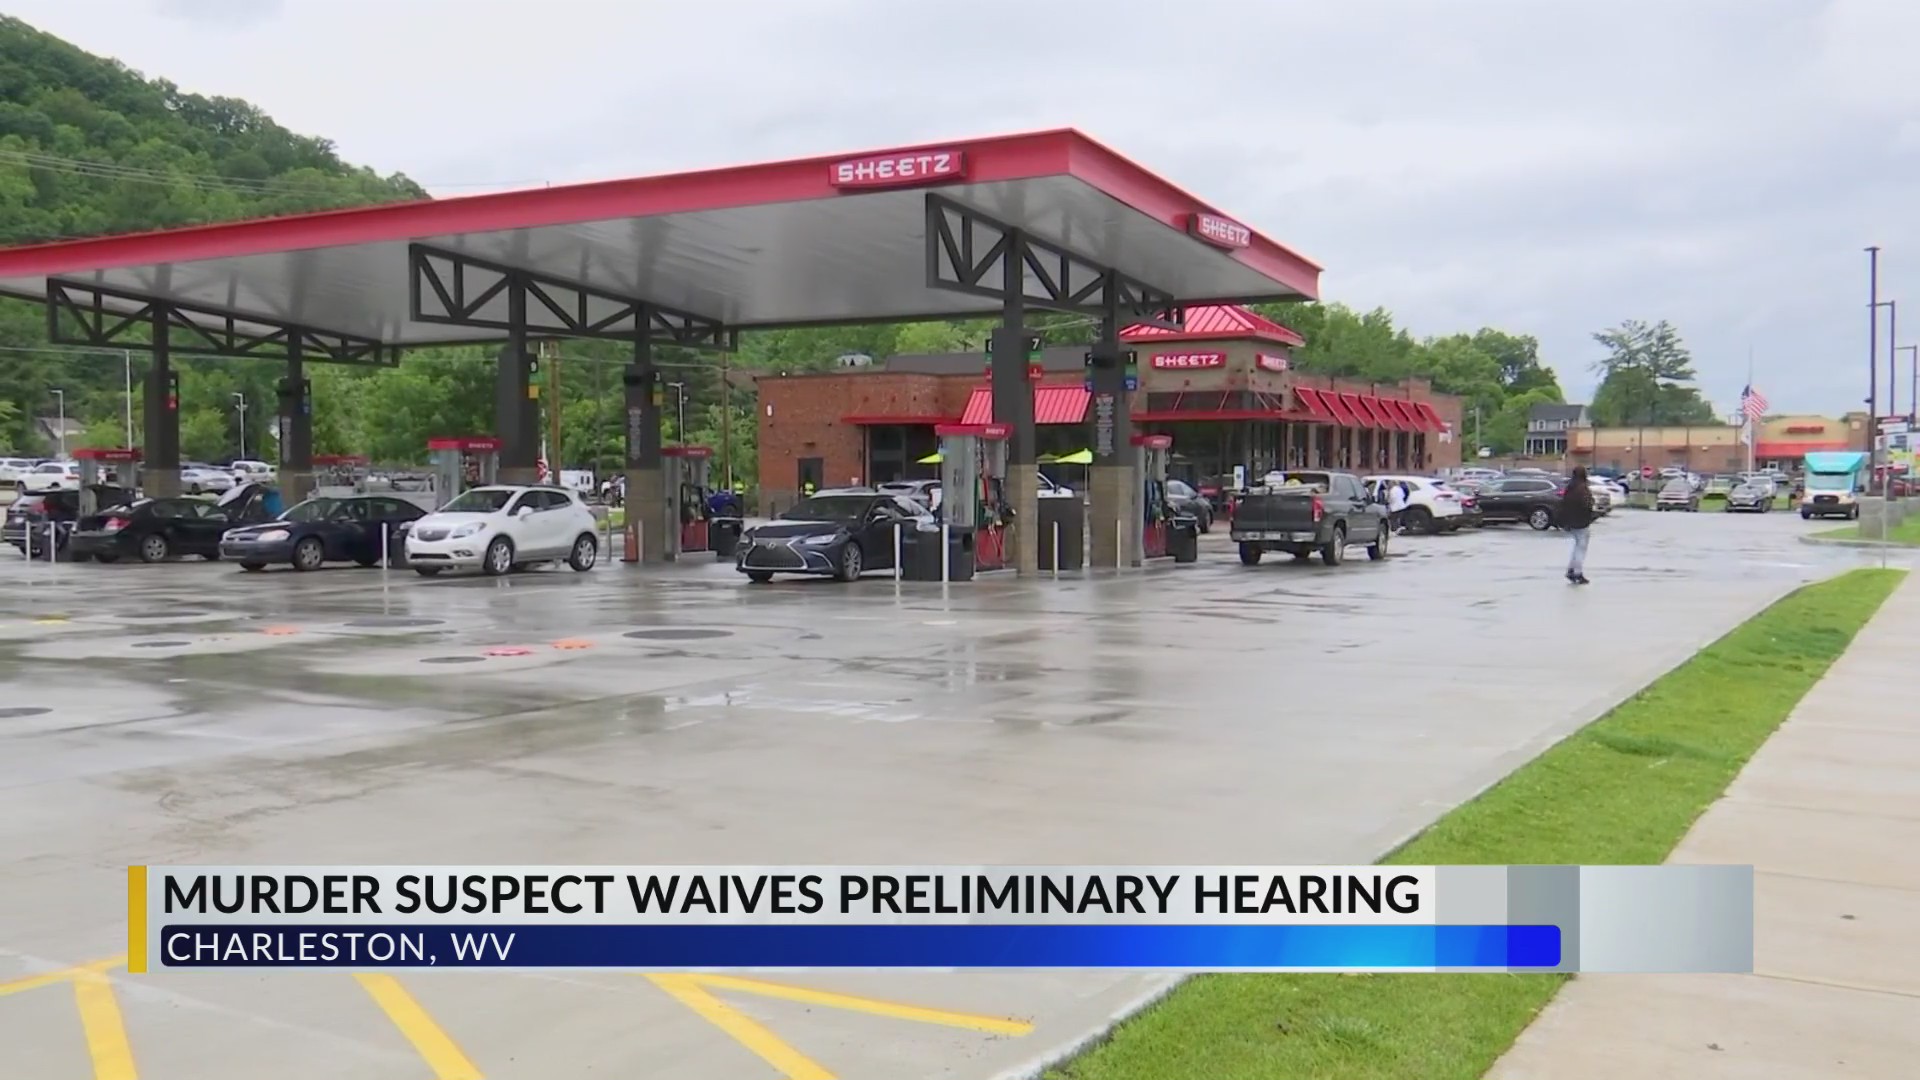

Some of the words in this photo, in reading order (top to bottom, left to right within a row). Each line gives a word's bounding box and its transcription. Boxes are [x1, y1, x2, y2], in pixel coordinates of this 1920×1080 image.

[838, 154, 950, 182] SHEETZ
[1202, 217, 1249, 245] SHEETZ
[1032, 338, 1040, 350] 7
[1155, 354, 1219, 367] SHEETZ
